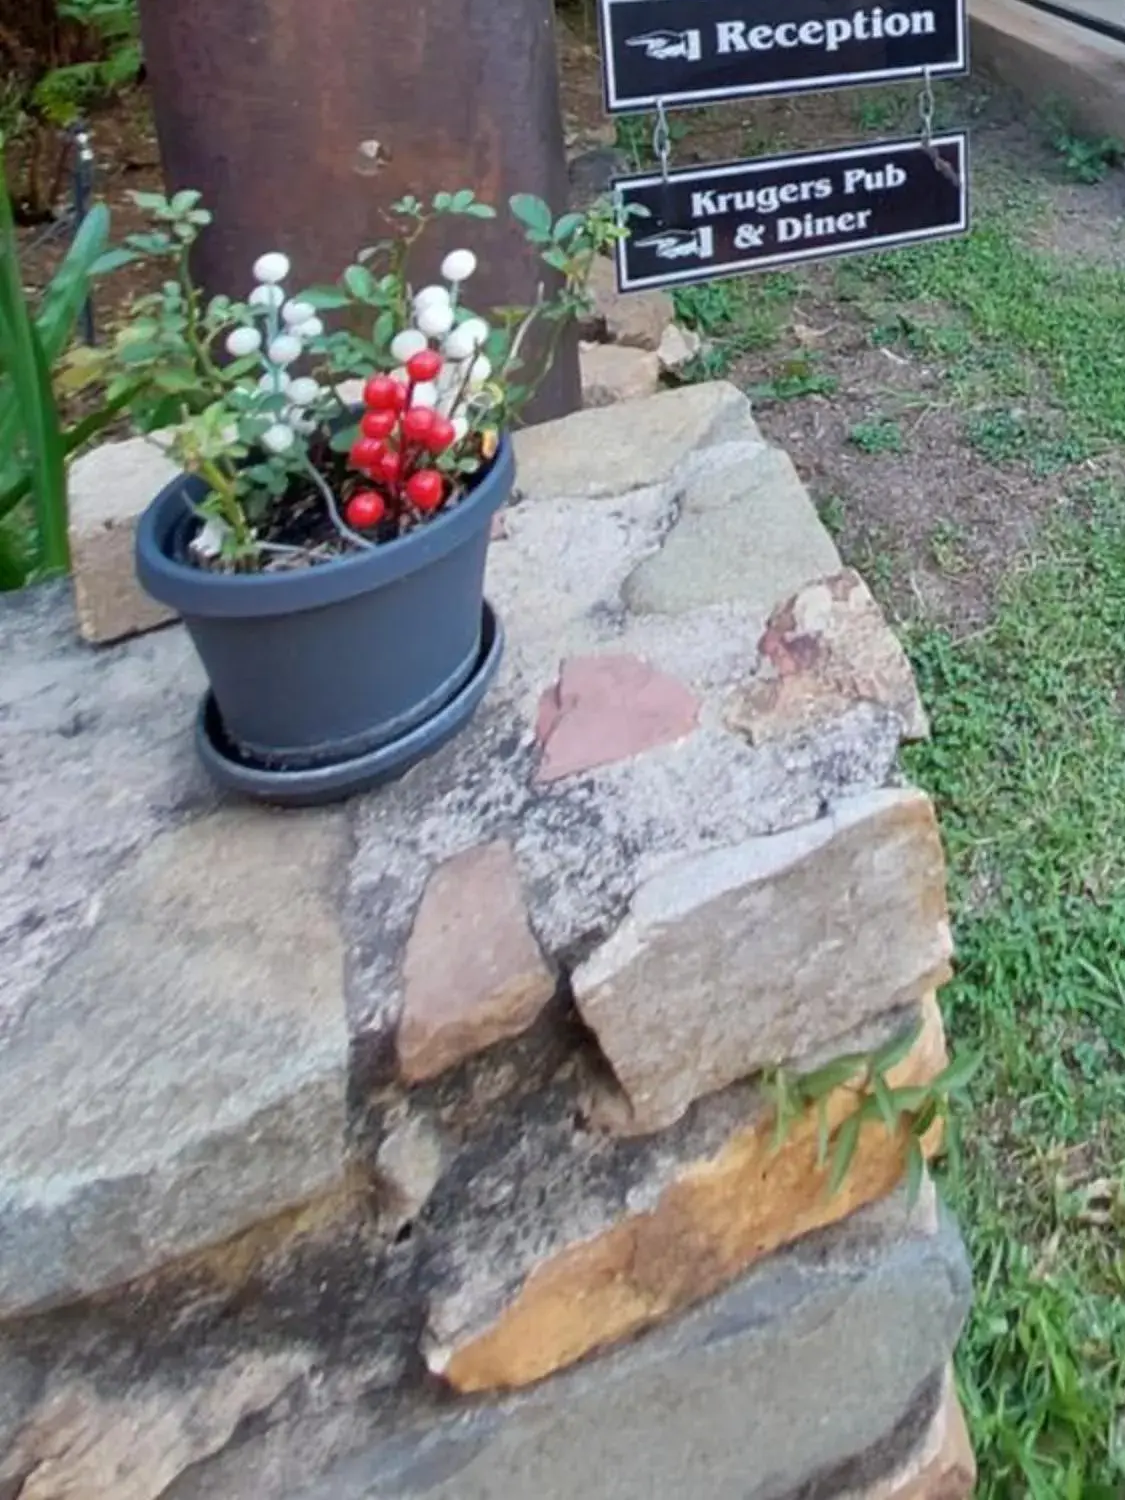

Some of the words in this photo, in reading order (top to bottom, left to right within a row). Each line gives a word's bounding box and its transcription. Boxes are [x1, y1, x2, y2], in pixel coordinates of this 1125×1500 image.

[716, 6, 936, 54] Reception
[690, 177, 832, 218] Krugers
[843, 163, 907, 194] Pub
[733, 222, 766, 249] &
[776, 208, 872, 243] Diner
